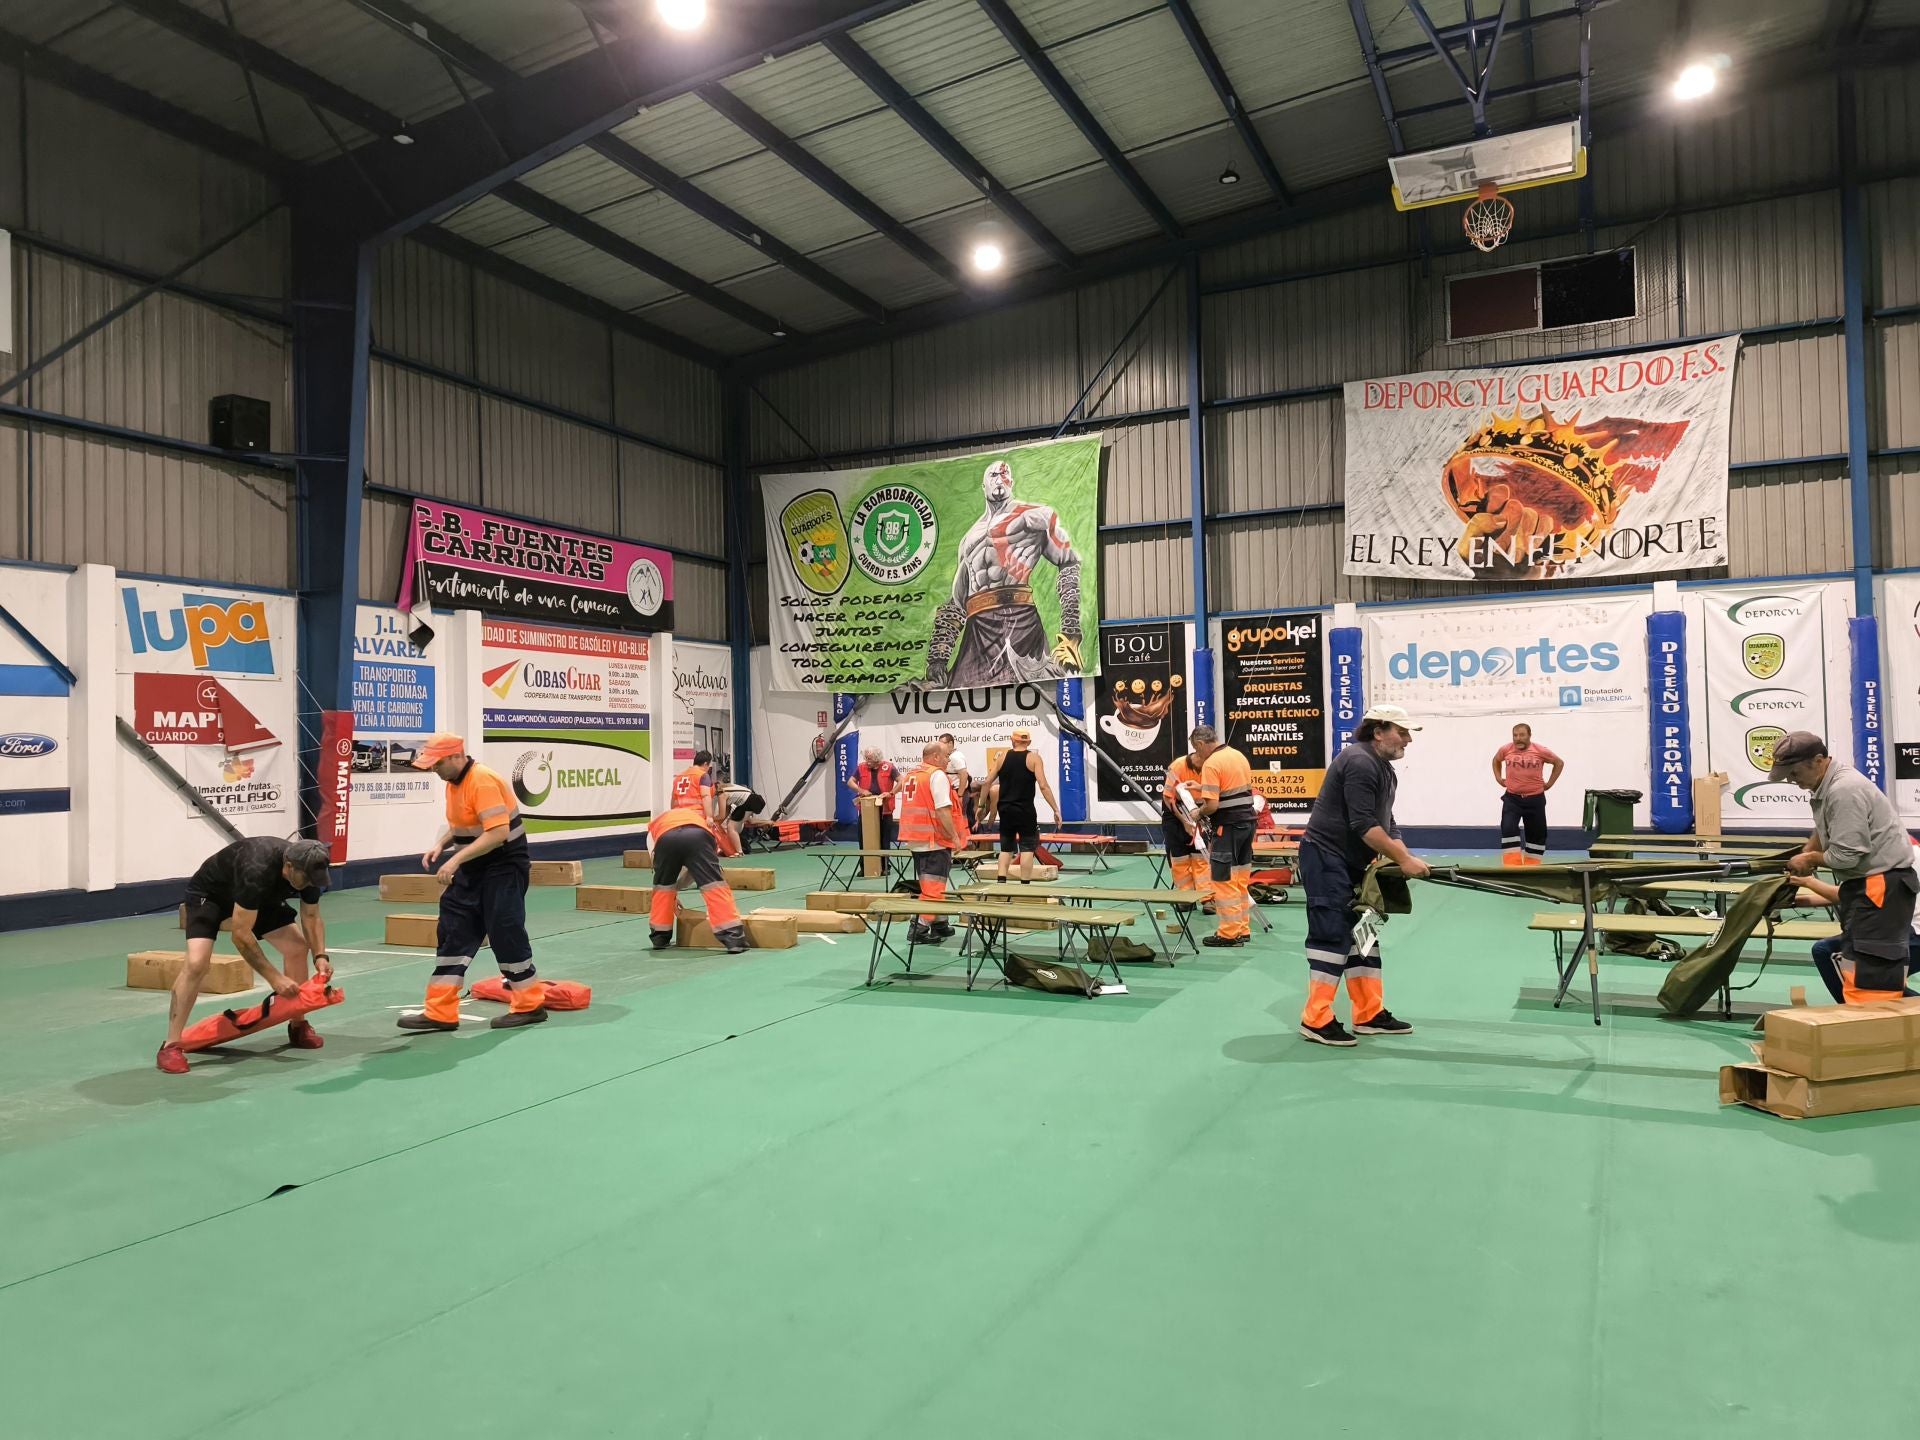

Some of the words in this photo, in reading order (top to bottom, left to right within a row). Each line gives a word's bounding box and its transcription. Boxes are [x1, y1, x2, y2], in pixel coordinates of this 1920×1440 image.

[1364, 376, 1511, 410] DEPORCYL
[1517, 355, 1674, 404] GUARDO
[1678, 343, 1726, 381] F.S.
[854, 511, 867, 527] LA
[863, 488, 934, 529] BOMBOBRIGADA
[482, 518, 615, 564] FUENTES
[1350, 533, 1382, 564] EL
[1390, 535, 1459, 567] REY
[1469, 534, 1516, 568] EN
[1528, 532, 1569, 567] EL
[1573, 516, 1718, 564] NORTE
[422, 530, 606, 582] CARRIONAS
[858, 553, 885, 578] GUARDO
[887, 570, 901, 580] F.S.
[902, 556, 922, 576] FANS
[427, 570, 510, 605] entimiento
[514, 587, 534, 606] de
[538, 595, 567, 609] una
[780, 596, 833, 607] SOLOS
[839, 592, 926, 607] PODEMOS
[793, 612, 848, 623] HACER
[854, 610, 906, 623] POCO,
[1744, 608, 1803, 618] DEPORCYL
[122, 586, 270, 668] lupa
[375, 614, 402, 636] J.L.
[815, 626, 884, 638] JUNTOS
[482, 626, 505, 642] IDAD
[506, 628, 518, 644] DE
[520, 630, 567, 648] SUMINISTRO
[568, 636, 578, 650] DE
[580, 633, 612, 653] GASÓLEO
[612, 640, 618, 654] Y
[618, 641, 647, 656] AD-BLUE
[779, 640, 928, 653] CONSEGUIREMOS
[1114, 635, 1164, 654] BOU
[791, 658, 833, 669] TODO
[840, 658, 864, 669] LO
[872, 656, 911, 668] QUE
[1128, 652, 1151, 662] café
[1388, 638, 1620, 686] deportes
[360, 666, 417, 684] TRANSPORTES
[801, 673, 900, 685] QUERAMOS
[352, 682, 374, 698] ENTA
[377, 683, 388, 698] DE
[390, 684, 428, 700] BIOMASA
[1243, 682, 1303, 692] ORQUESTAS
[1338, 654, 1354, 720] DISEÑO
[1584, 686, 1623, 696] Diputación
[524, 692, 560, 700] COOPERATIVA
[890, 682, 1041, 715] VICAUTO
[1236, 694, 1312, 706] ESPECTÁCULOS
[1596, 694, 1632, 702] PALENCIA
[352, 699, 375, 713] VENTA
[377, 700, 386, 713] DE
[388, 701, 424, 714] CARBONES
[1748, 700, 1806, 710] DEPORCYL
[360, 712, 378, 727] LEÑA
[380, 715, 386, 727] A
[387, 715, 422, 728] DOMICILIO
[483, 714, 494, 722] OL.
[494, 714, 507, 722] IND.
[548, 716, 574, 724] GUARDO
[1198, 700, 1206, 726] DISE
[1228, 710, 1274, 720] SOPORTE
[1276, 708, 1320, 718] TÉCNICO
[934, 721, 956, 730] único
[957, 719, 1014, 729] concesionario
[1015, 718, 1040, 728] oficial
[1251, 722, 1298, 733] PARQUES
[146, 731, 198, 741] GUARDO
[982, 734, 991, 742] de
[1125, 729, 1145, 740] BOU
[1245, 732, 1304, 742] INFANTILES
[1, 736, 44, 754] Ford
[1252, 746, 1298, 756] EVENTOS
[839, 744, 847, 782] PROMAIL
[1062, 740, 1072, 782] PROMAIL
[1866, 736, 1880, 782] PROMAI
[1662, 726, 1684, 808] PROMAIL
[556, 766, 622, 789] RENECAL
[235, 783, 246, 792] de
[248, 782, 271, 790] frutas
[1252, 786, 1306, 794] 9.05.30.46
[202, 790, 279, 805] STALAYO
[334, 760, 348, 836] MAPFRE
[1752, 794, 1809, 803] DEPORCYL
